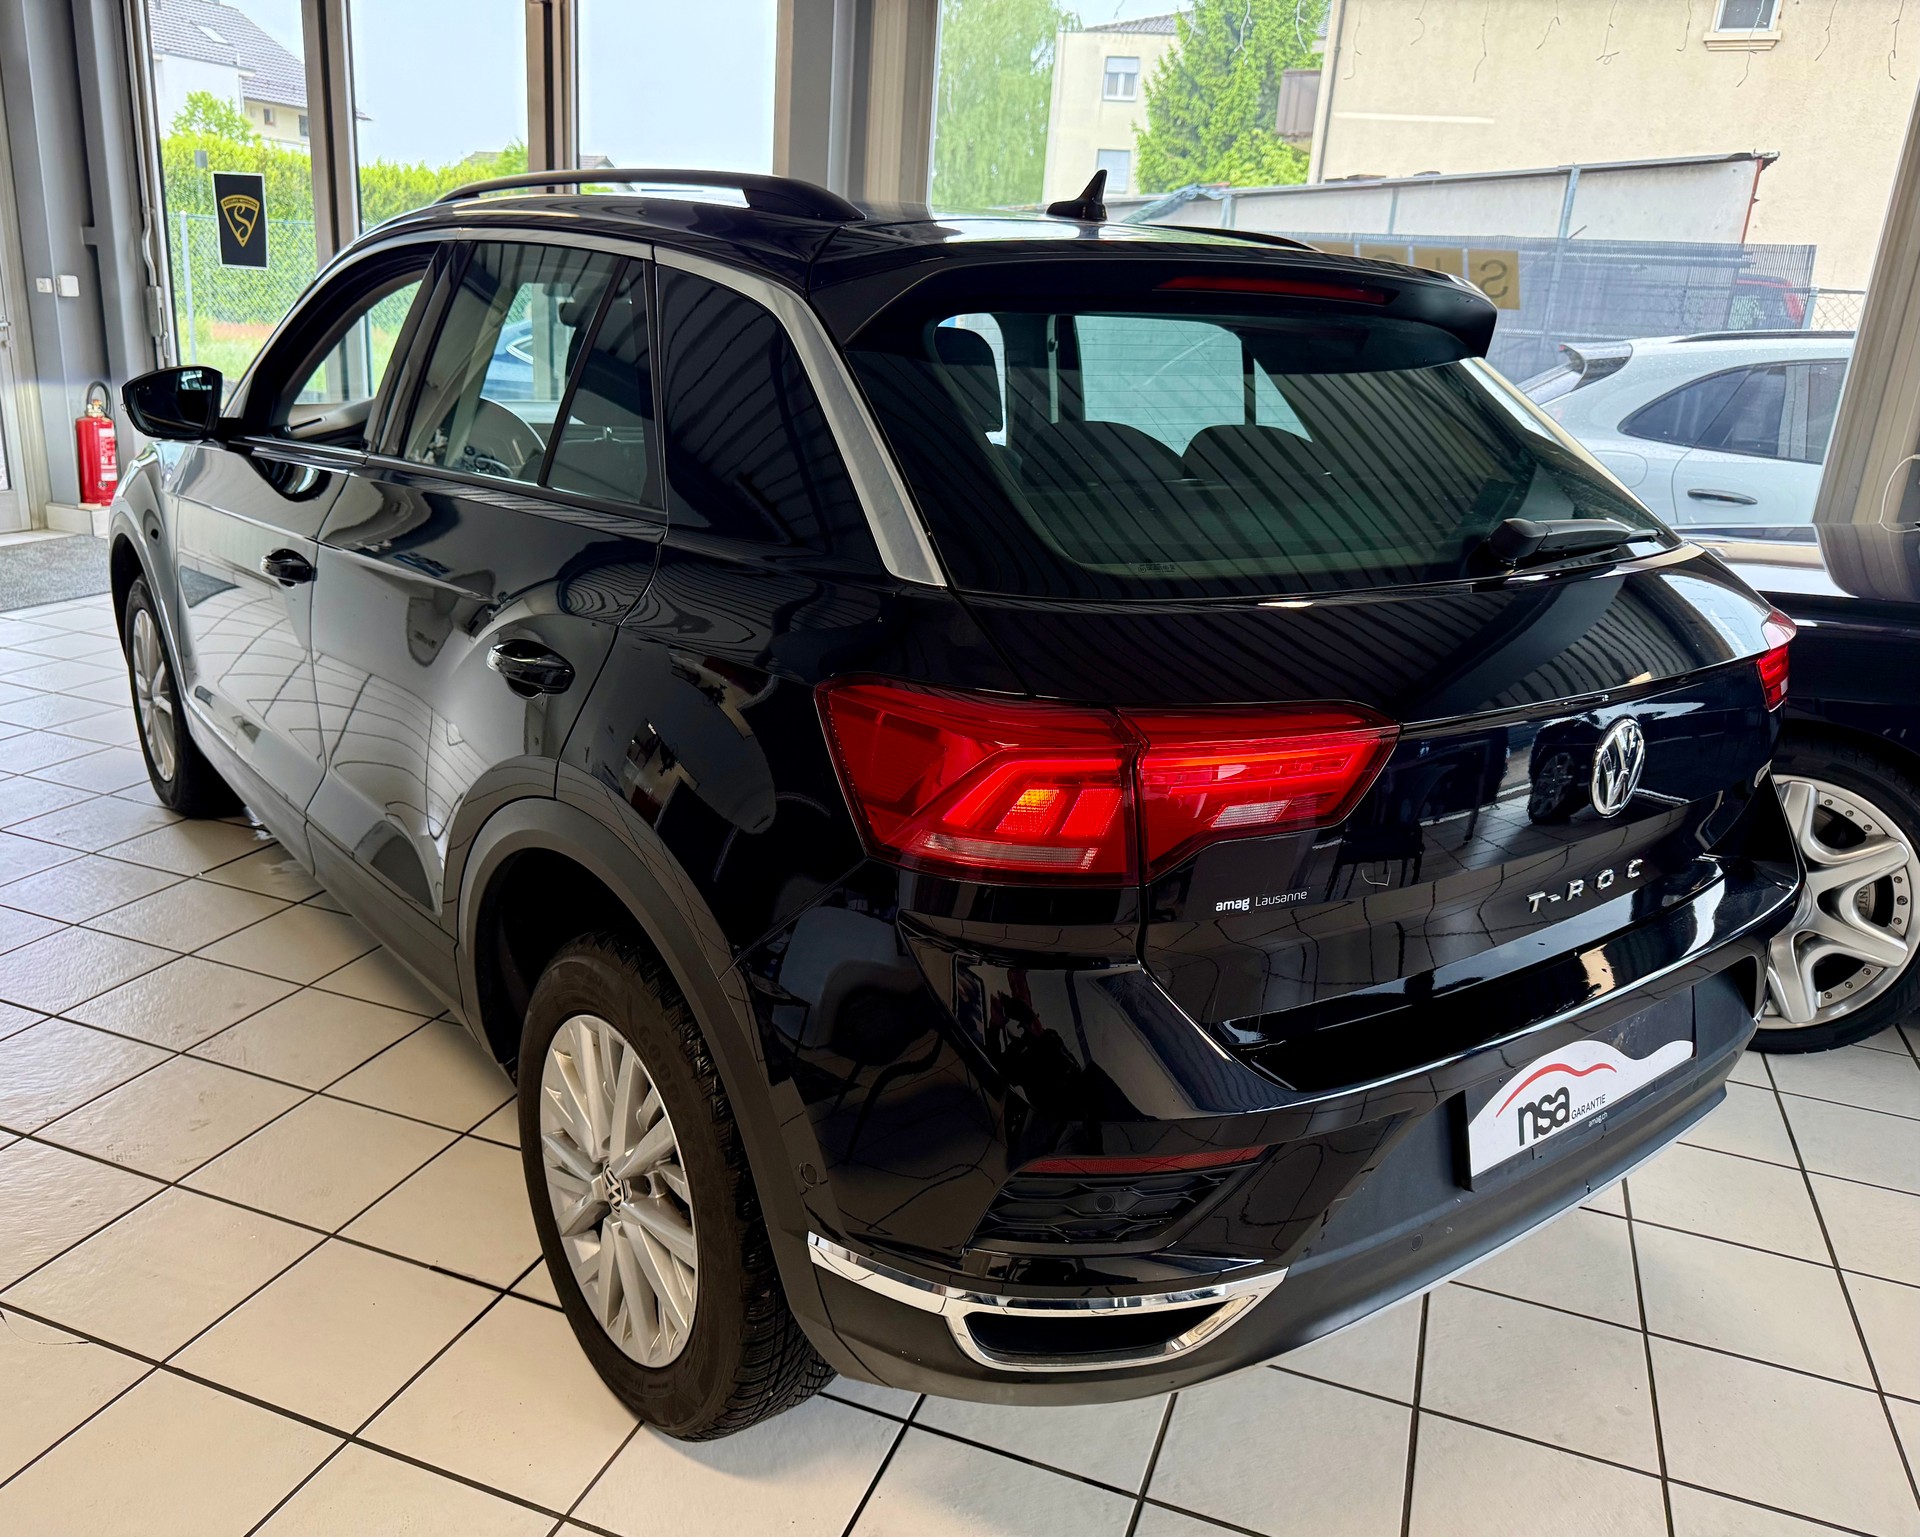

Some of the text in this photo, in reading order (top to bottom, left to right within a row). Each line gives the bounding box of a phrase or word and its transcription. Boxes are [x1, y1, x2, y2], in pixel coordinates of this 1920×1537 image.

[1215, 891, 1308, 912] amag Lausanne
[1525, 858, 1643, 914] T-ROC
[1517, 1086, 1606, 1146] nsa GARANTIE
[1588, 1112, 1608, 1128] amag.ch
